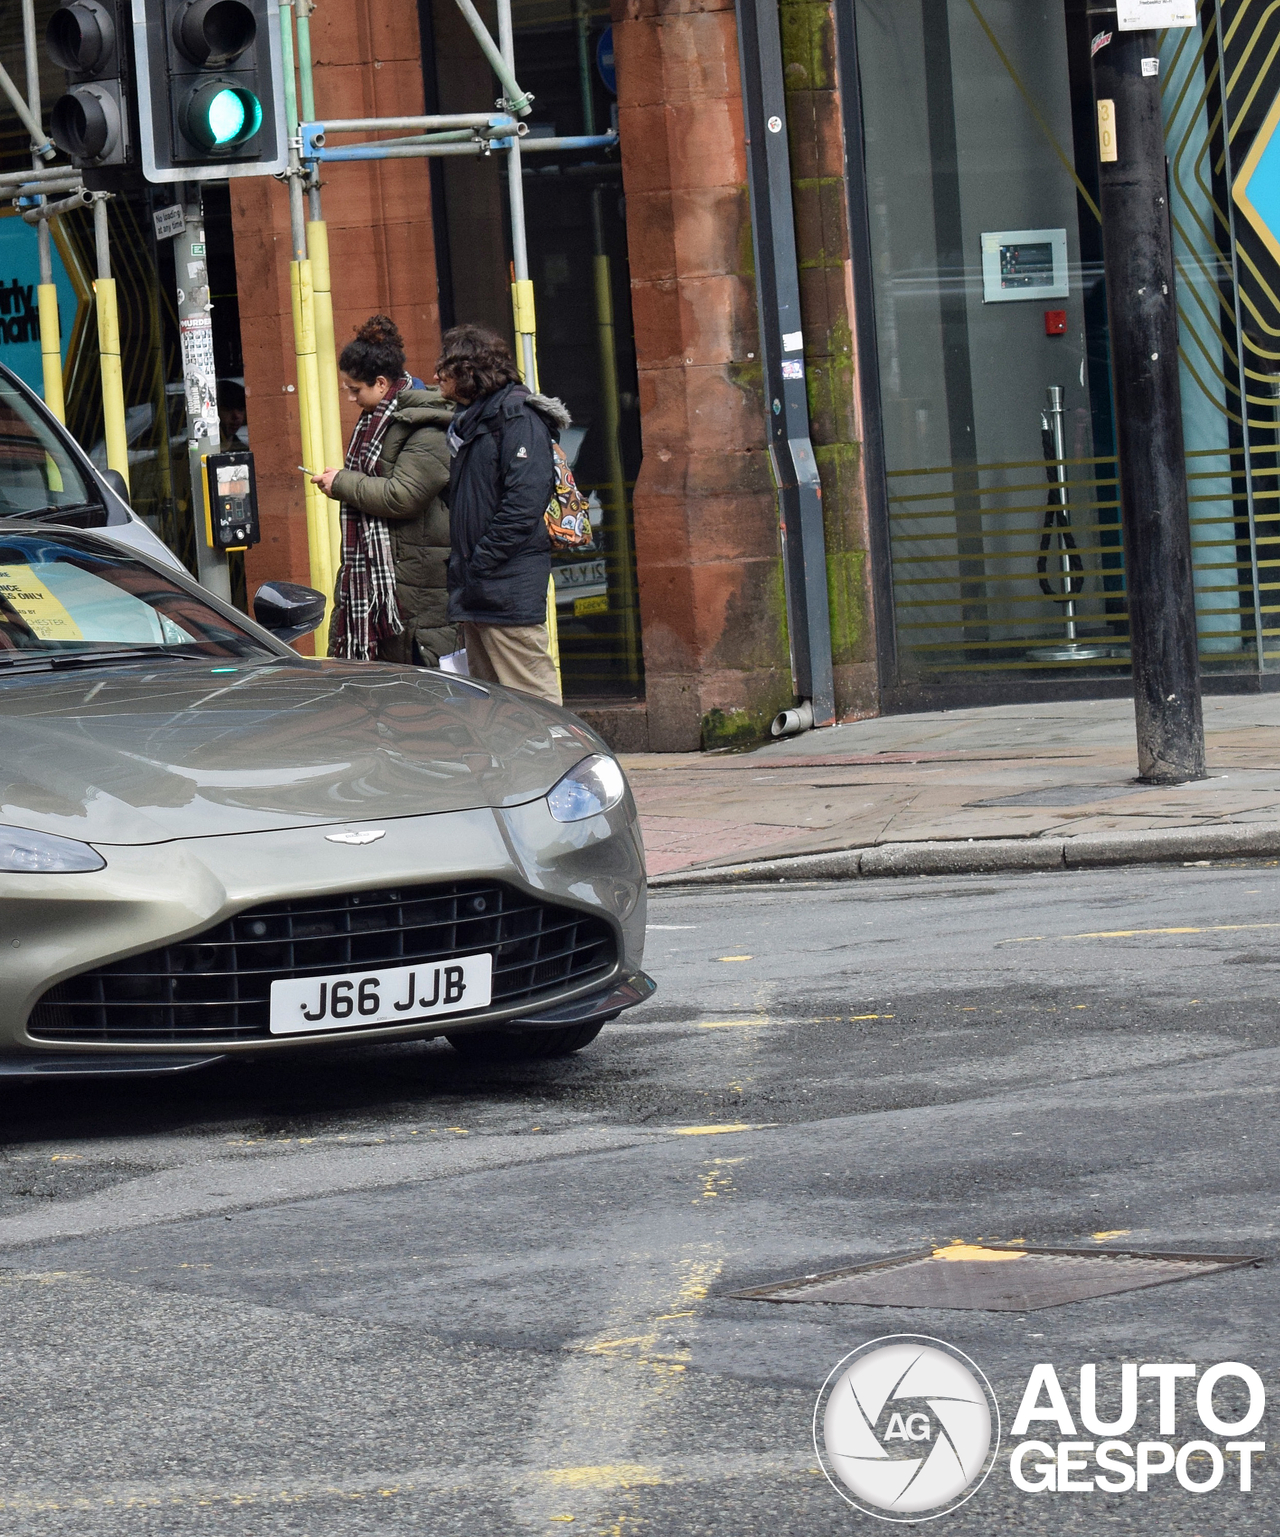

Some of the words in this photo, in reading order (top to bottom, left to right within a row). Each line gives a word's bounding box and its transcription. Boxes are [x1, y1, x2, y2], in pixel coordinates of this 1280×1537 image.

[155, 214, 163, 223] No
[163, 210, 180, 221] loading
[163, 225, 171, 233] any
[172, 220, 183, 230] time
[18, 592, 45, 600] ONLY
[25, 618, 68, 626] CHESTER
[303, 977, 381, 1022] J66
[394, 966, 465, 1011] JJB
